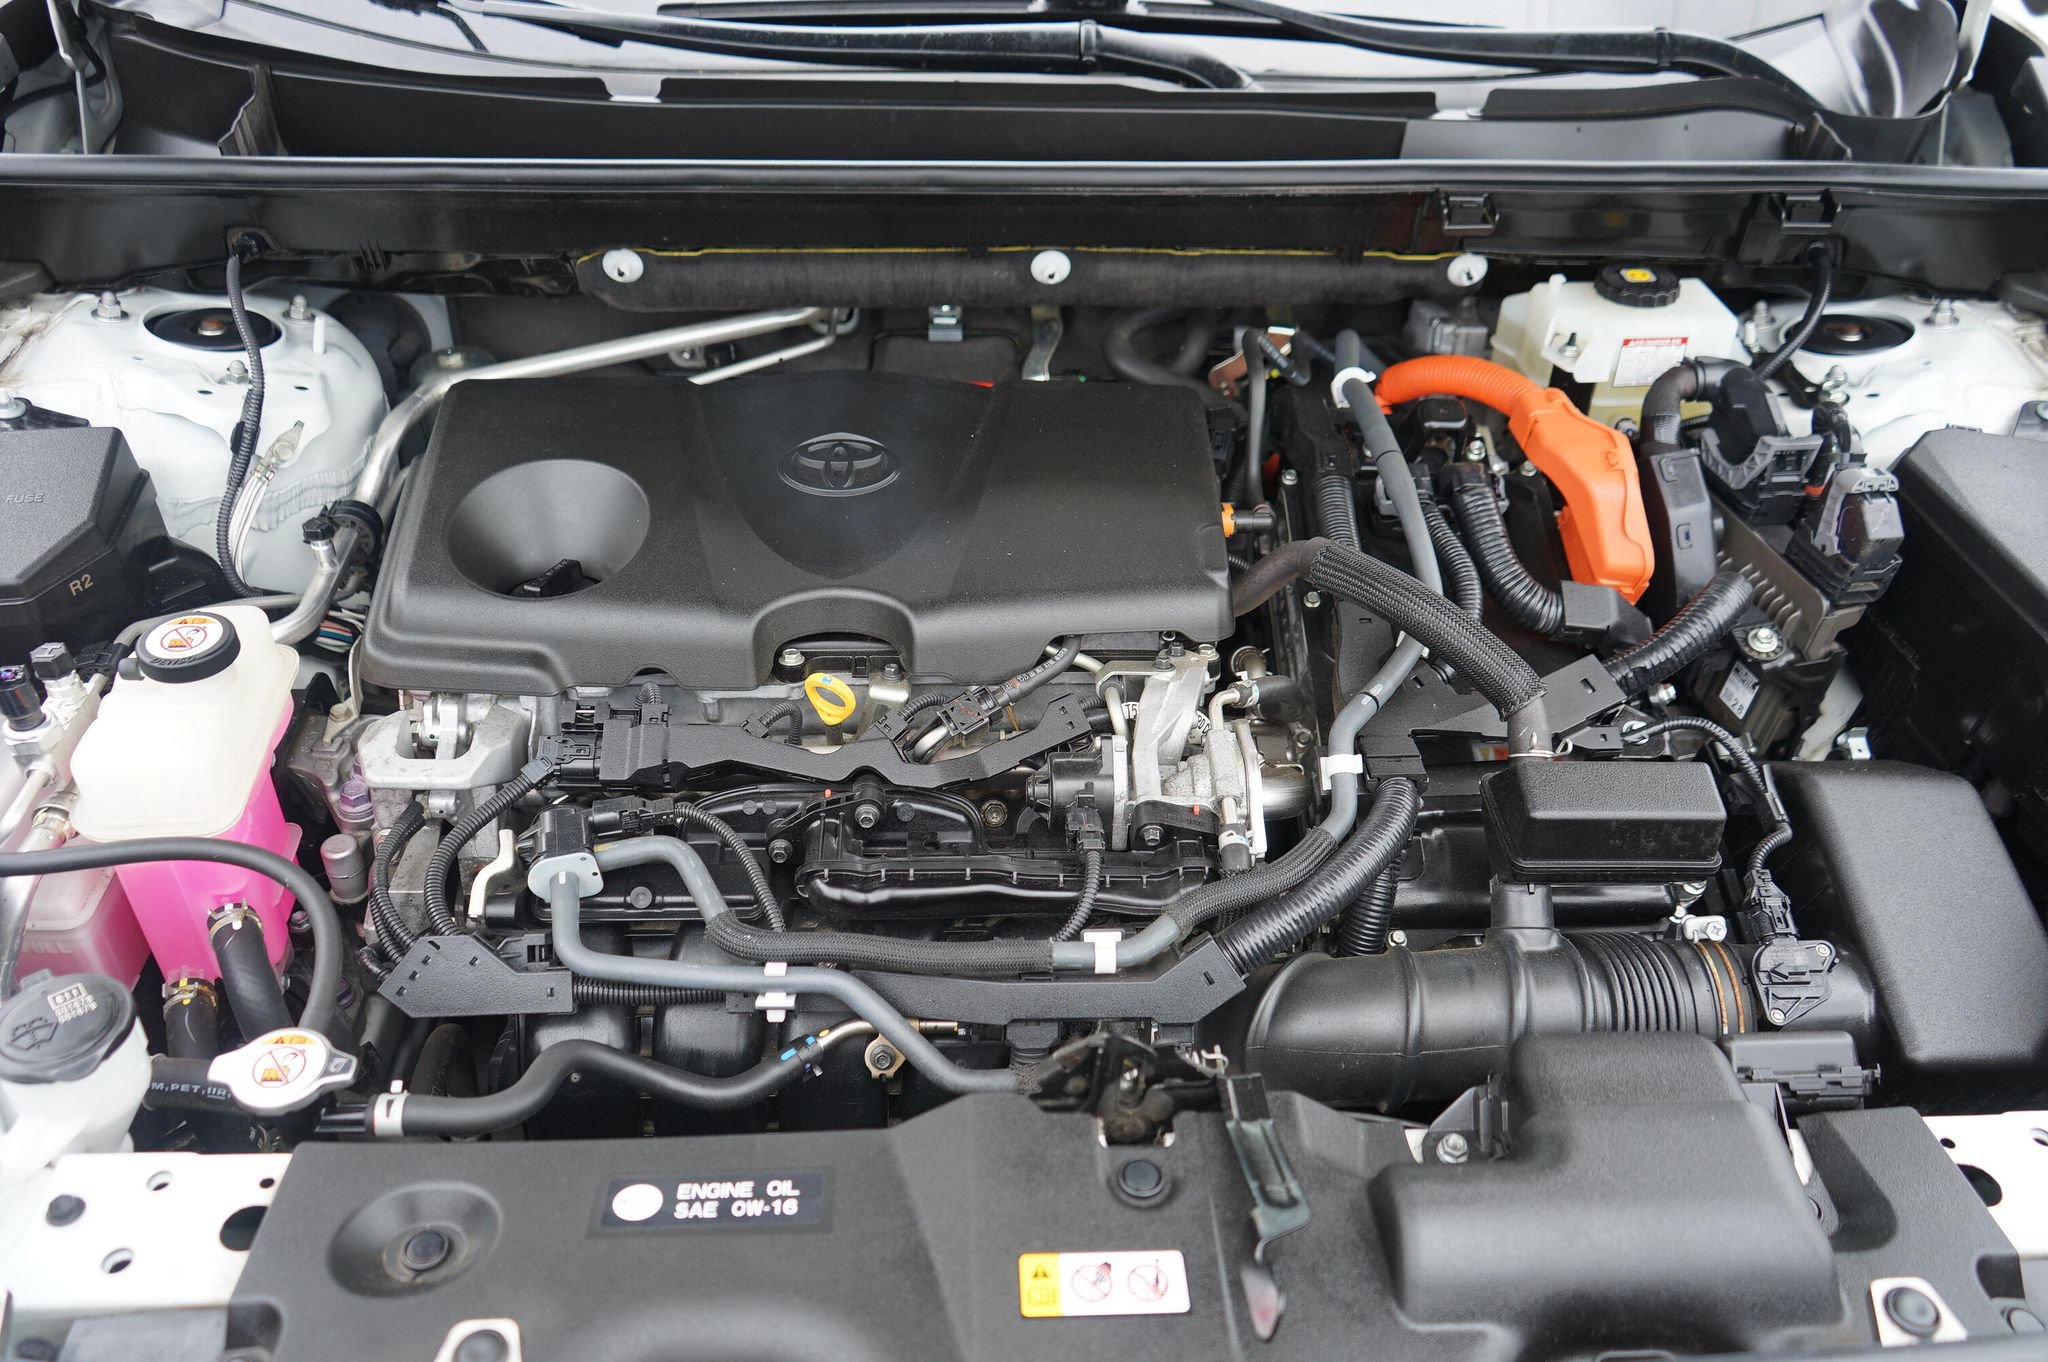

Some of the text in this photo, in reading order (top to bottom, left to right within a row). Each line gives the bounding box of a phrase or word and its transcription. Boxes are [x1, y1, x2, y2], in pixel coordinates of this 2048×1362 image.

[5, 493, 45, 504] FUSE
[68, 573, 94, 597] R2
[676, 1179, 801, 1200] ENGINE OIL
[673, 1200, 720, 1220] SAE
